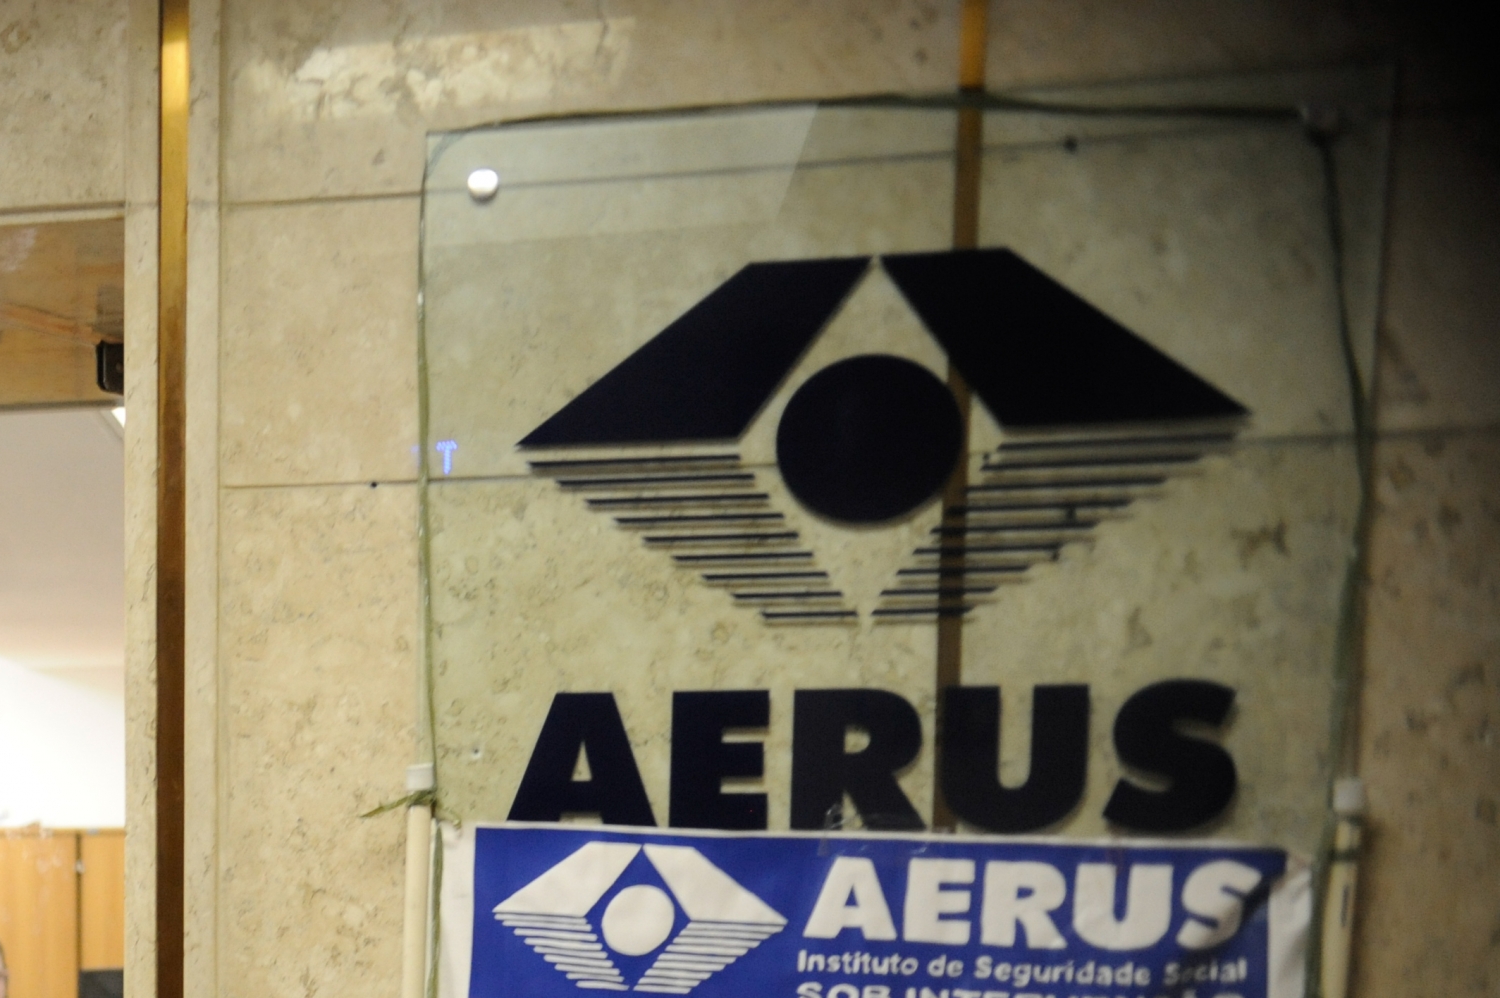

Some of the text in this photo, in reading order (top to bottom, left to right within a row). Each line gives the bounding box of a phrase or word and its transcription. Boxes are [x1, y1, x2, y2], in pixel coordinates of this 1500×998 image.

[506, 679, 1239, 836] AERUS
[802, 855, 1263, 952] AERUS
[798, 950, 1248, 988] Instituto de Seguridade Social
